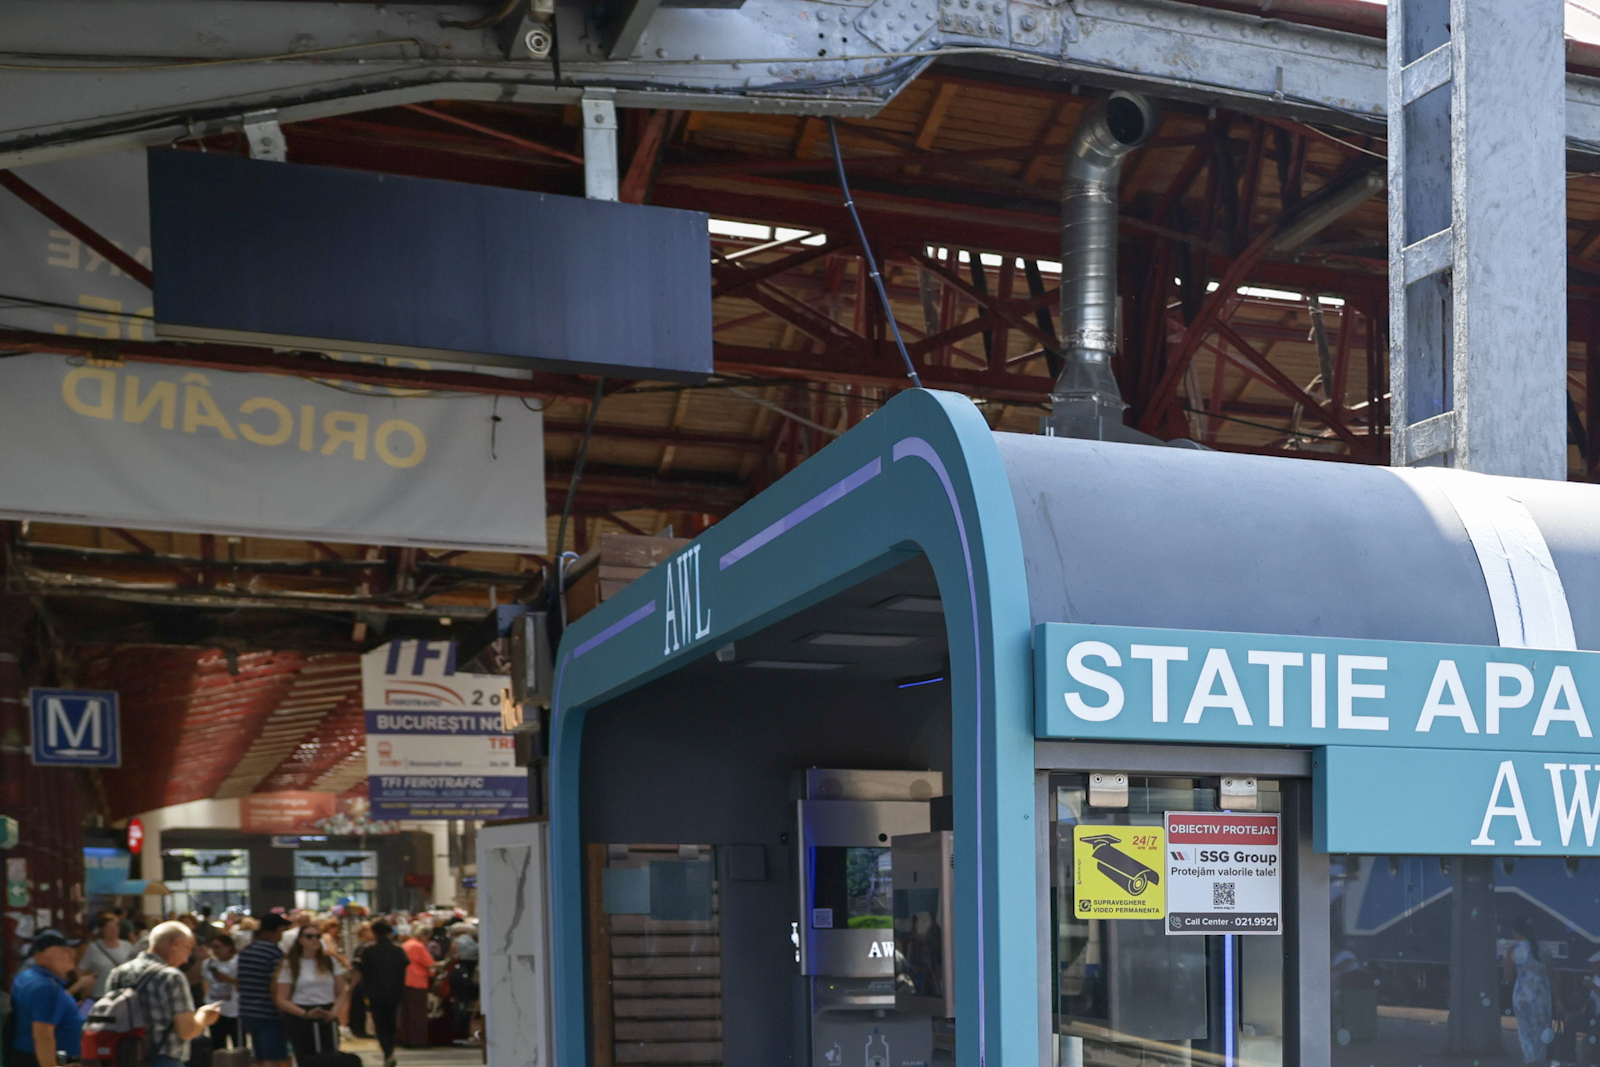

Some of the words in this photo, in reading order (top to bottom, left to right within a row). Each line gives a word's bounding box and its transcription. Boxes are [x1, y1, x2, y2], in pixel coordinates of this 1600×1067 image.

[664, 543, 711, 656] AWL
[1063, 639, 1390, 731] STATIE
[1415, 658, 1594, 738] APA
[471, 690, 484, 706] 2
[47, 698, 102, 749] M
[480, 717, 504, 731] NO
[1169, 824, 1221, 834] OBIECTIV
[1222, 825, 1277, 835] PROTEJAT
[1132, 835, 1158, 847] 24/7
[1200, 850, 1230, 864] SSG
[1233, 851, 1278, 866] Group
[1171, 866, 1216, 877] Protejăm
[1218, 867, 1254, 877] valorile
[1255, 868, 1277, 877] tale!
[1185, 917, 1201, 926] Call
[1201, 917, 1229, 926] Center
[1234, 917, 1277, 926] 021.9921
[868, 942, 895, 958] AW
